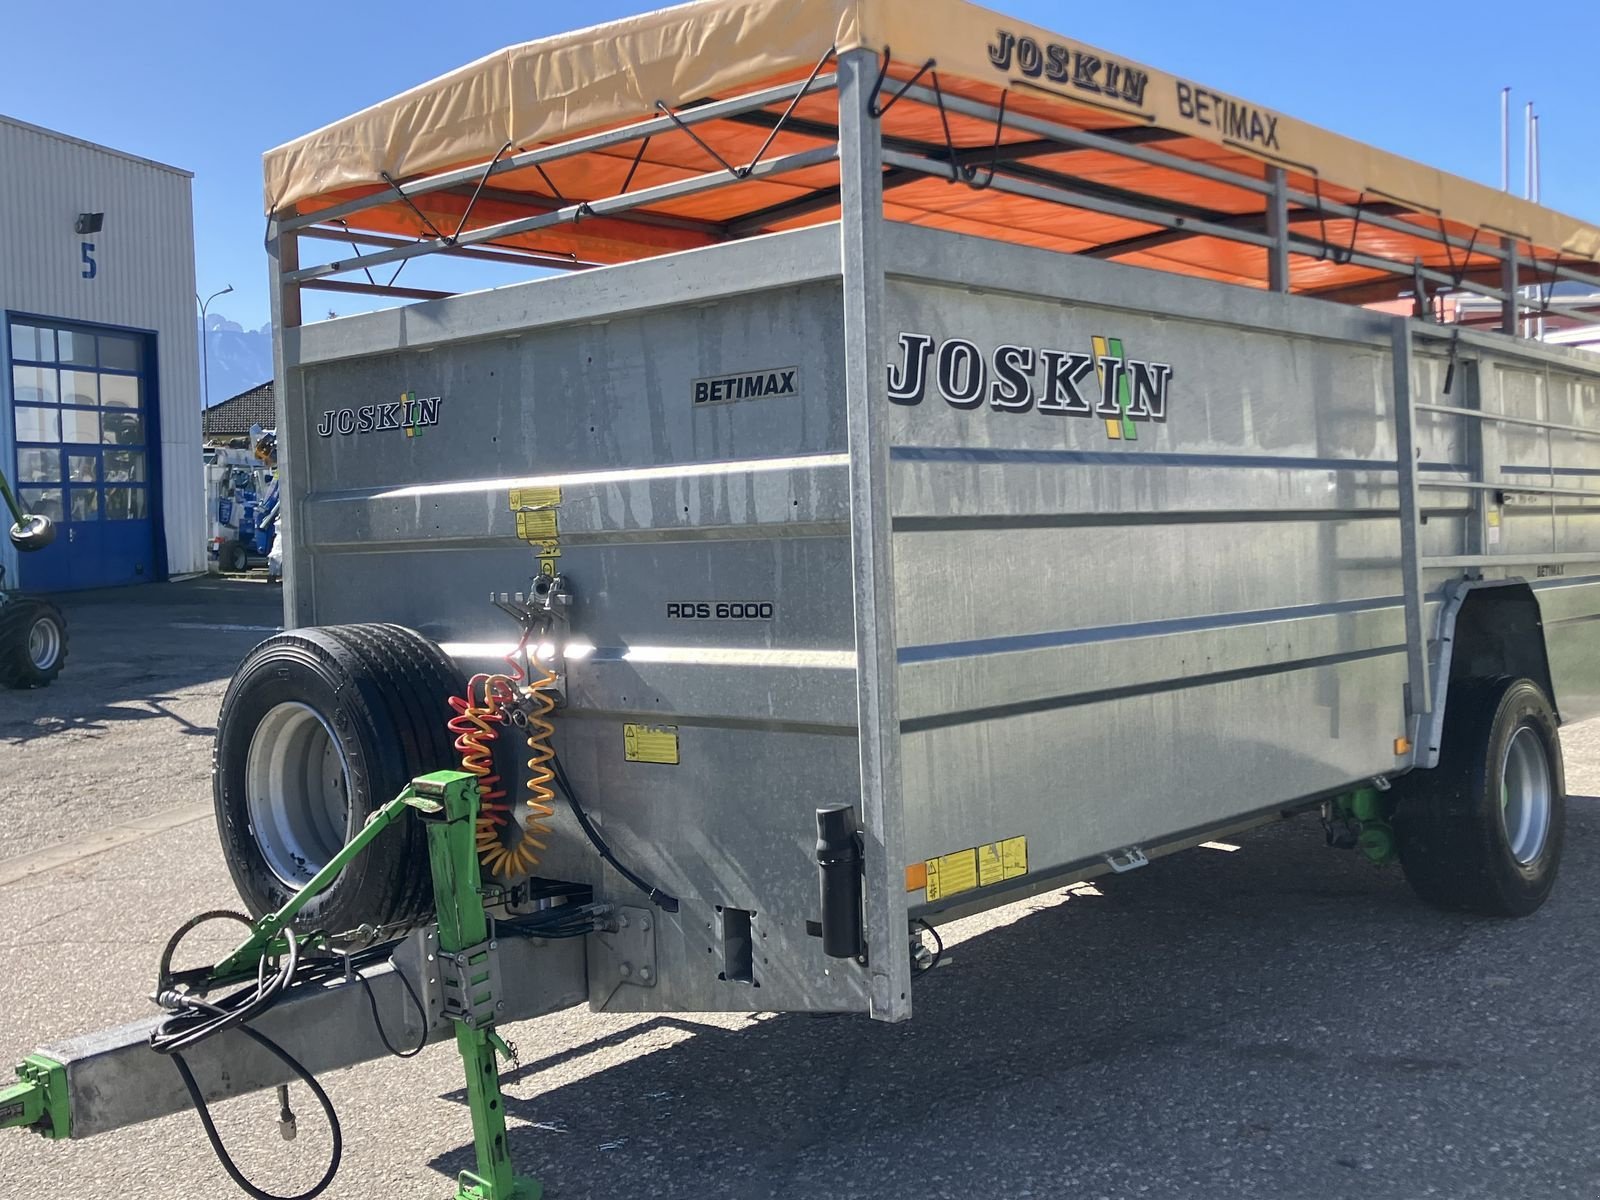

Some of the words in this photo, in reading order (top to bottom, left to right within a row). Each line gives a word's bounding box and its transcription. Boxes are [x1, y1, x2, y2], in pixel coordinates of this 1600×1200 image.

[988, 29, 1149, 106] JOSKIN
[1175, 79, 1280, 150] BETIMAX
[81, 242, 97, 279] 5
[695, 371, 796, 403] BETIMAX
[887, 332, 1173, 423] JOSKIN
[667, 603, 711, 619] RDS
[716, 603, 773, 619] 6000
